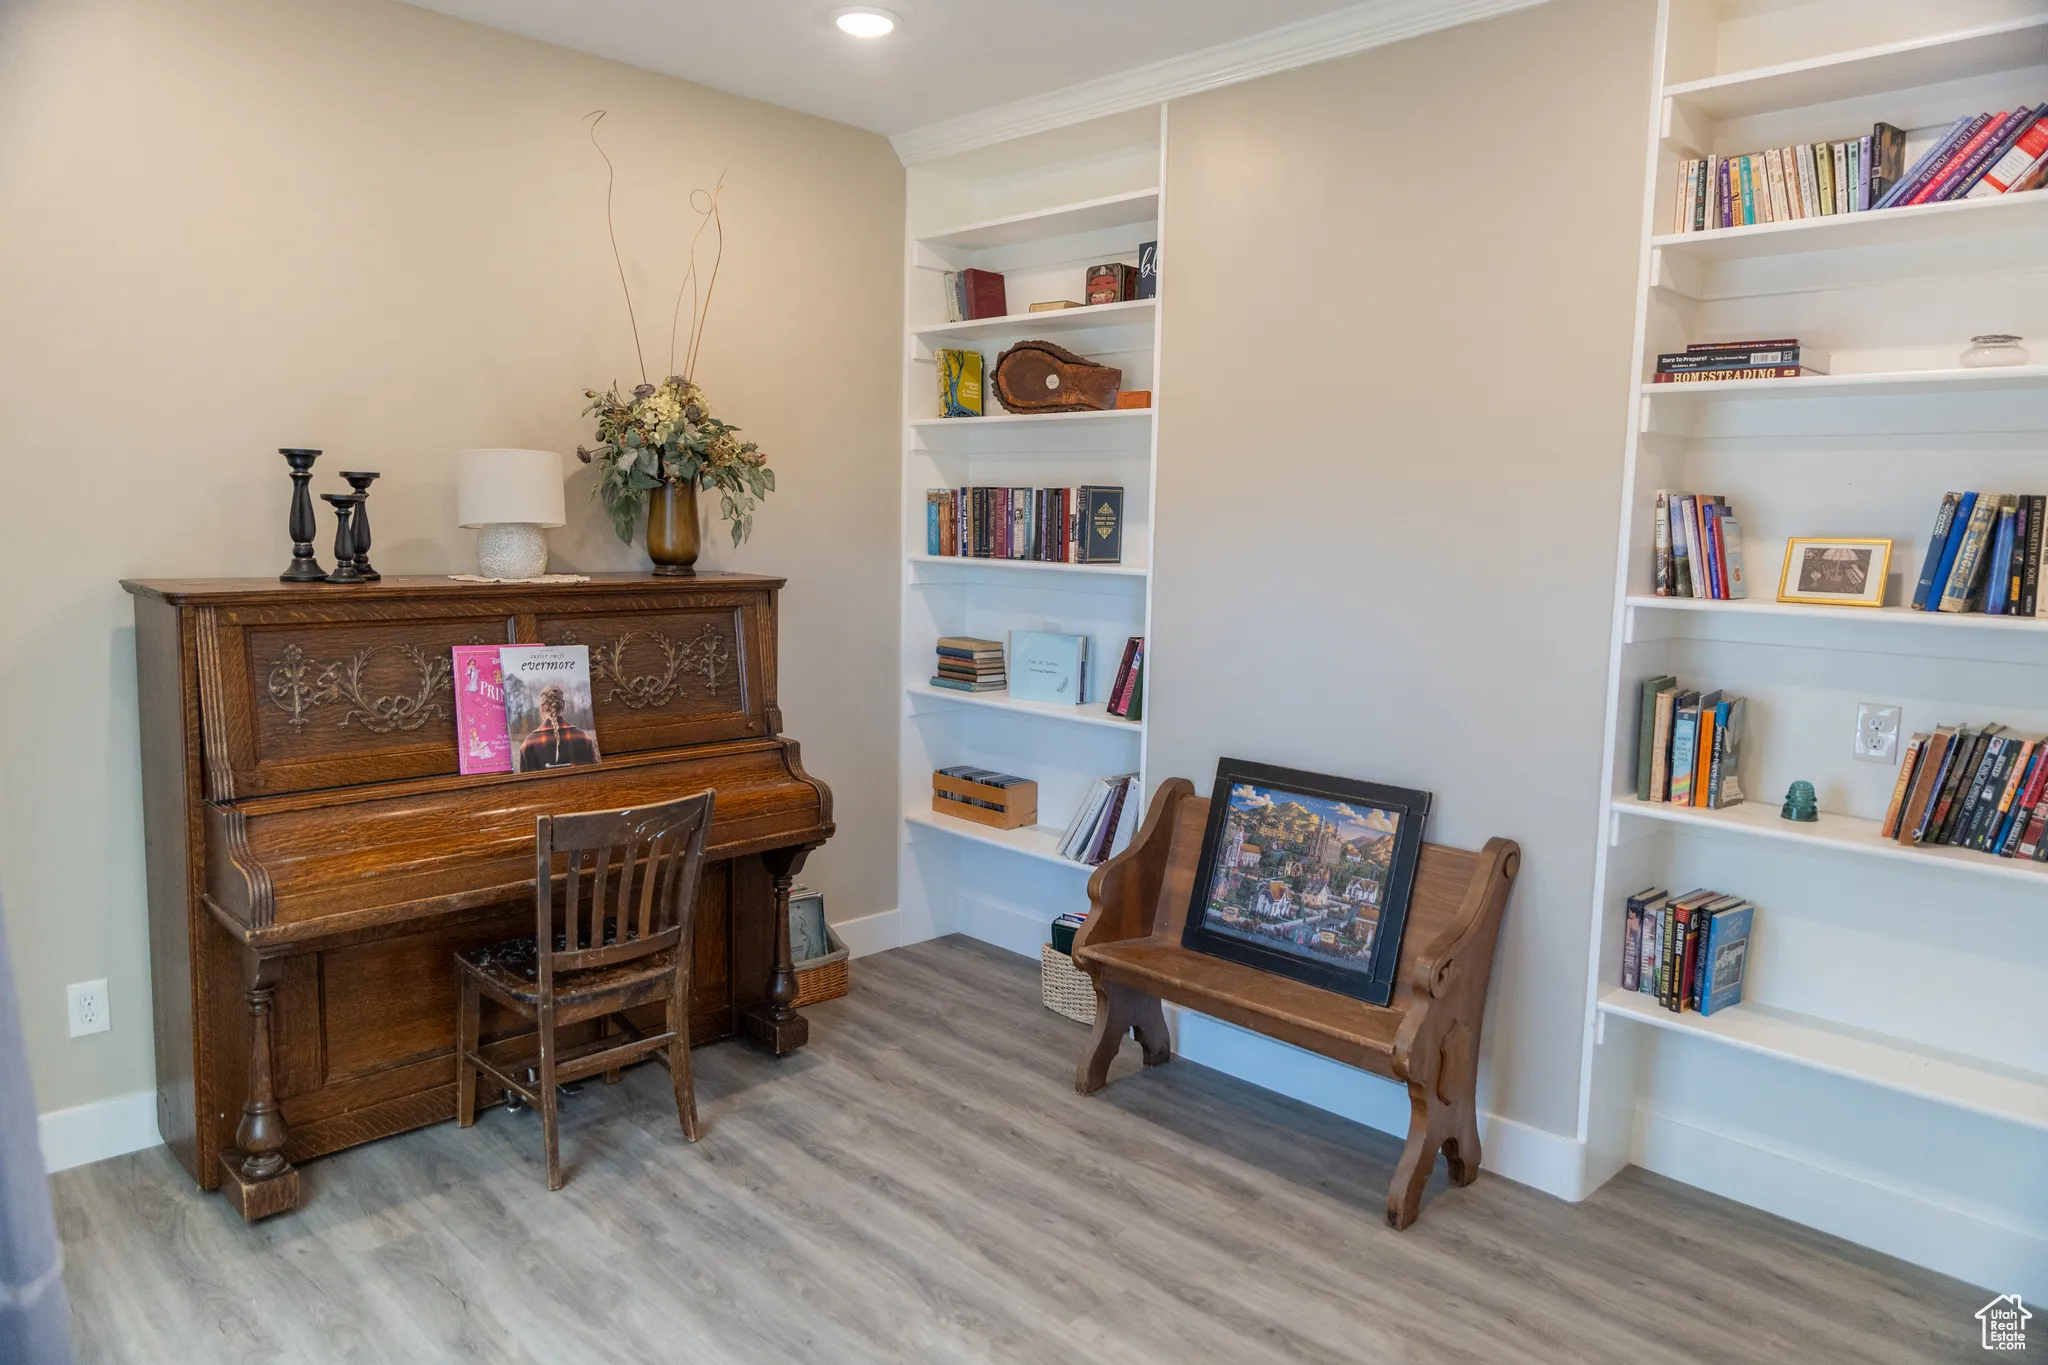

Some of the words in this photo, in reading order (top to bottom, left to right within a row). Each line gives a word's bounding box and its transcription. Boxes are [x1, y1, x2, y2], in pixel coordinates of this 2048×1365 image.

[1969, 113, 1988, 133] FIRST
[1951, 131, 1971, 150] LOVE
[1962, 128, 1989, 155] SECOND
[1965, 137, 1998, 169] FOREVER
[1919, 154, 1949, 184] FOREVER
[1935, 152, 1965, 183] CHANCES
[1674, 369, 1776, 383] HOMESTEADING
[2034, 499, 2041, 509] HE
[2030, 512, 2040, 553] RESTORETH
[2029, 554, 2036, 565] MY
[2027, 567, 2035, 586] SOUL
[521, 660, 575, 671] evermore
[1900, 750, 1914, 781] ECKHART
[1894, 780, 1906, 800] TOLLE
[1700, 920, 1708, 947] GLENN
[1626, 941, 1636, 966] HEIR
[1643, 929, 1654, 974] delirium
[1676, 940, 1684, 955] BECK
[1698, 948, 1706, 968] BECK
[1663, 965, 1671, 981] GLENN
